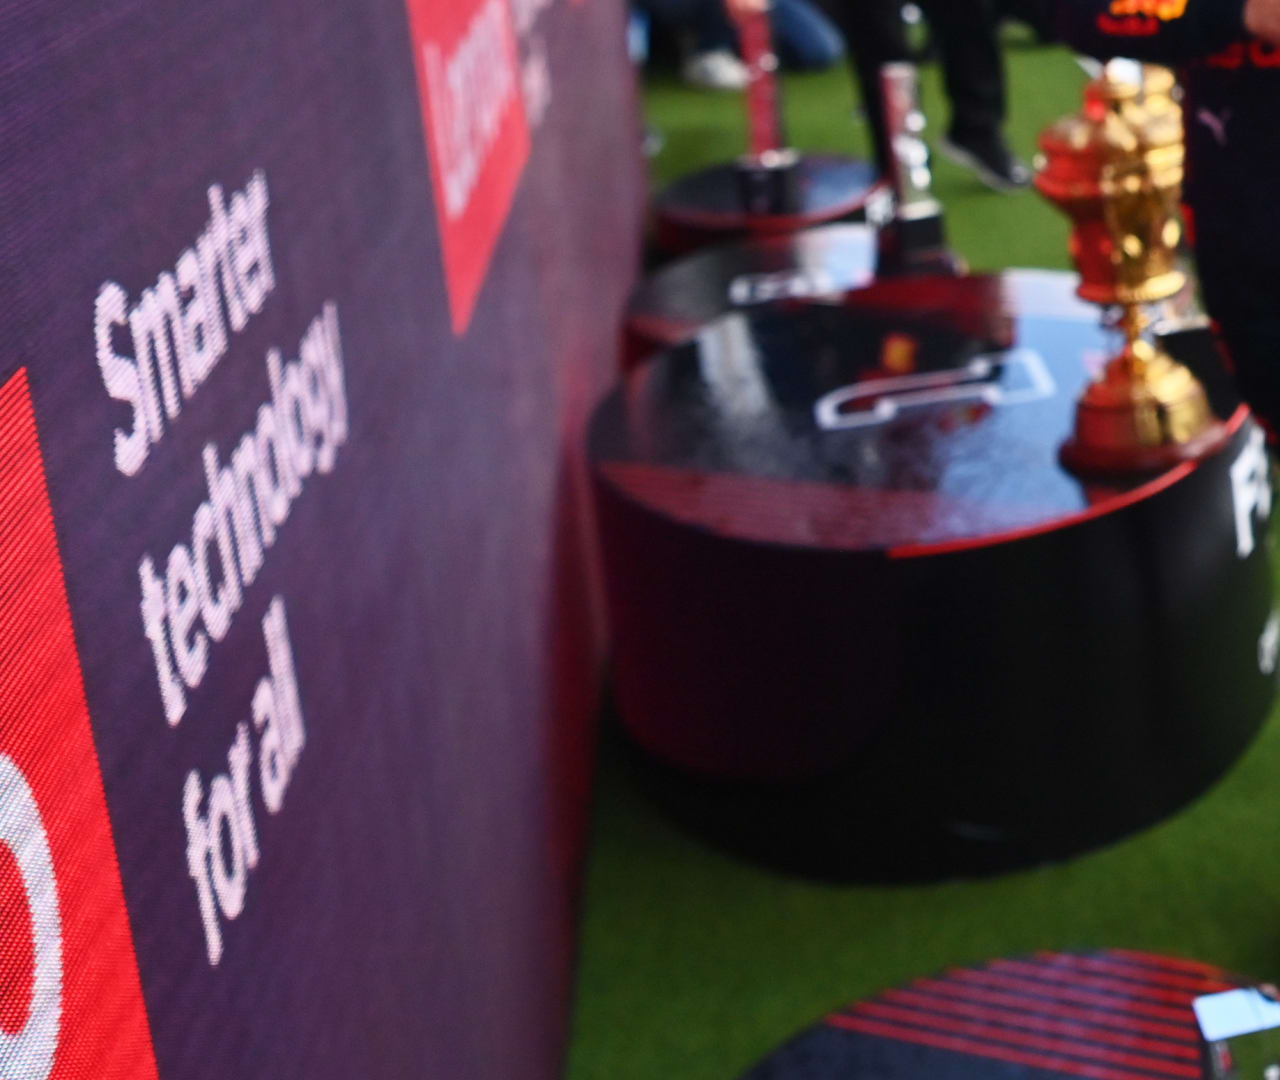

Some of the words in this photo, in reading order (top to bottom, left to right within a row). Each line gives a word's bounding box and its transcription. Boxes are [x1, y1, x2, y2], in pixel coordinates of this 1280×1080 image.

[95, 168, 276, 478] Smarter
[138, 300, 349, 728] technology
[182, 722, 261, 966] for
[252, 595, 306, 815] all
